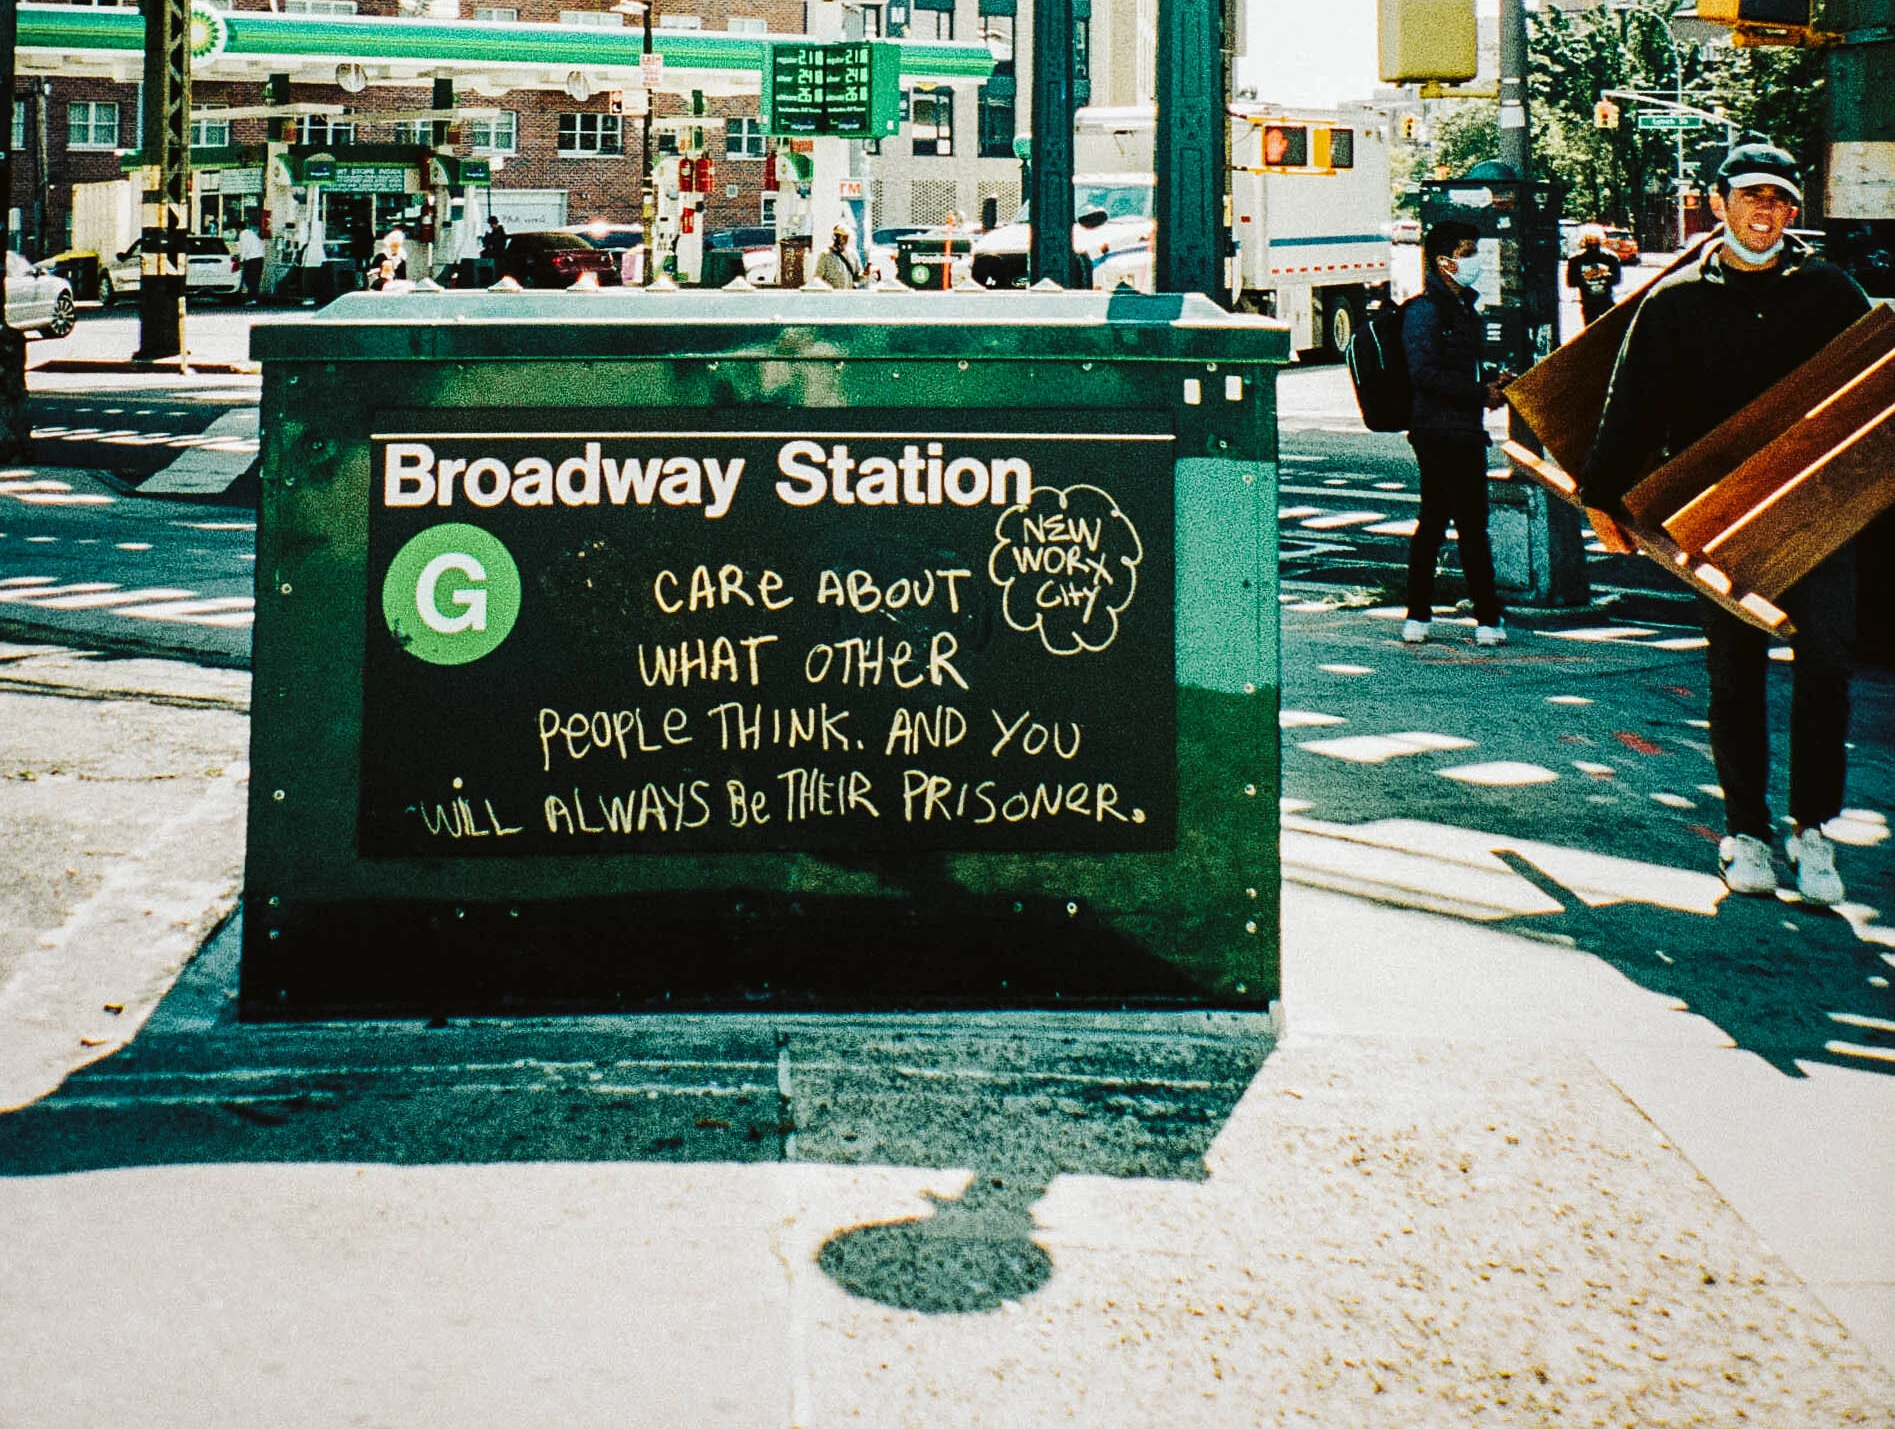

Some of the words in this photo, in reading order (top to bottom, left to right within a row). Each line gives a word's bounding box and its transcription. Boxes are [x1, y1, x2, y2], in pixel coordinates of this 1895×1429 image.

[384, 441, 746, 519] Broadway
[775, 439, 1032, 507] Station
[1023, 514, 1102, 552] NEW
[416, 552, 487, 633] G
[817, 568, 972, 614] ABOUT
[638, 634, 779, 687] WHAT
[885, 704, 967, 756] AND
[991, 709, 1081, 759] YOU
[544, 780, 710, 835] ALWAYS
[777, 767, 880, 822] THEIR
